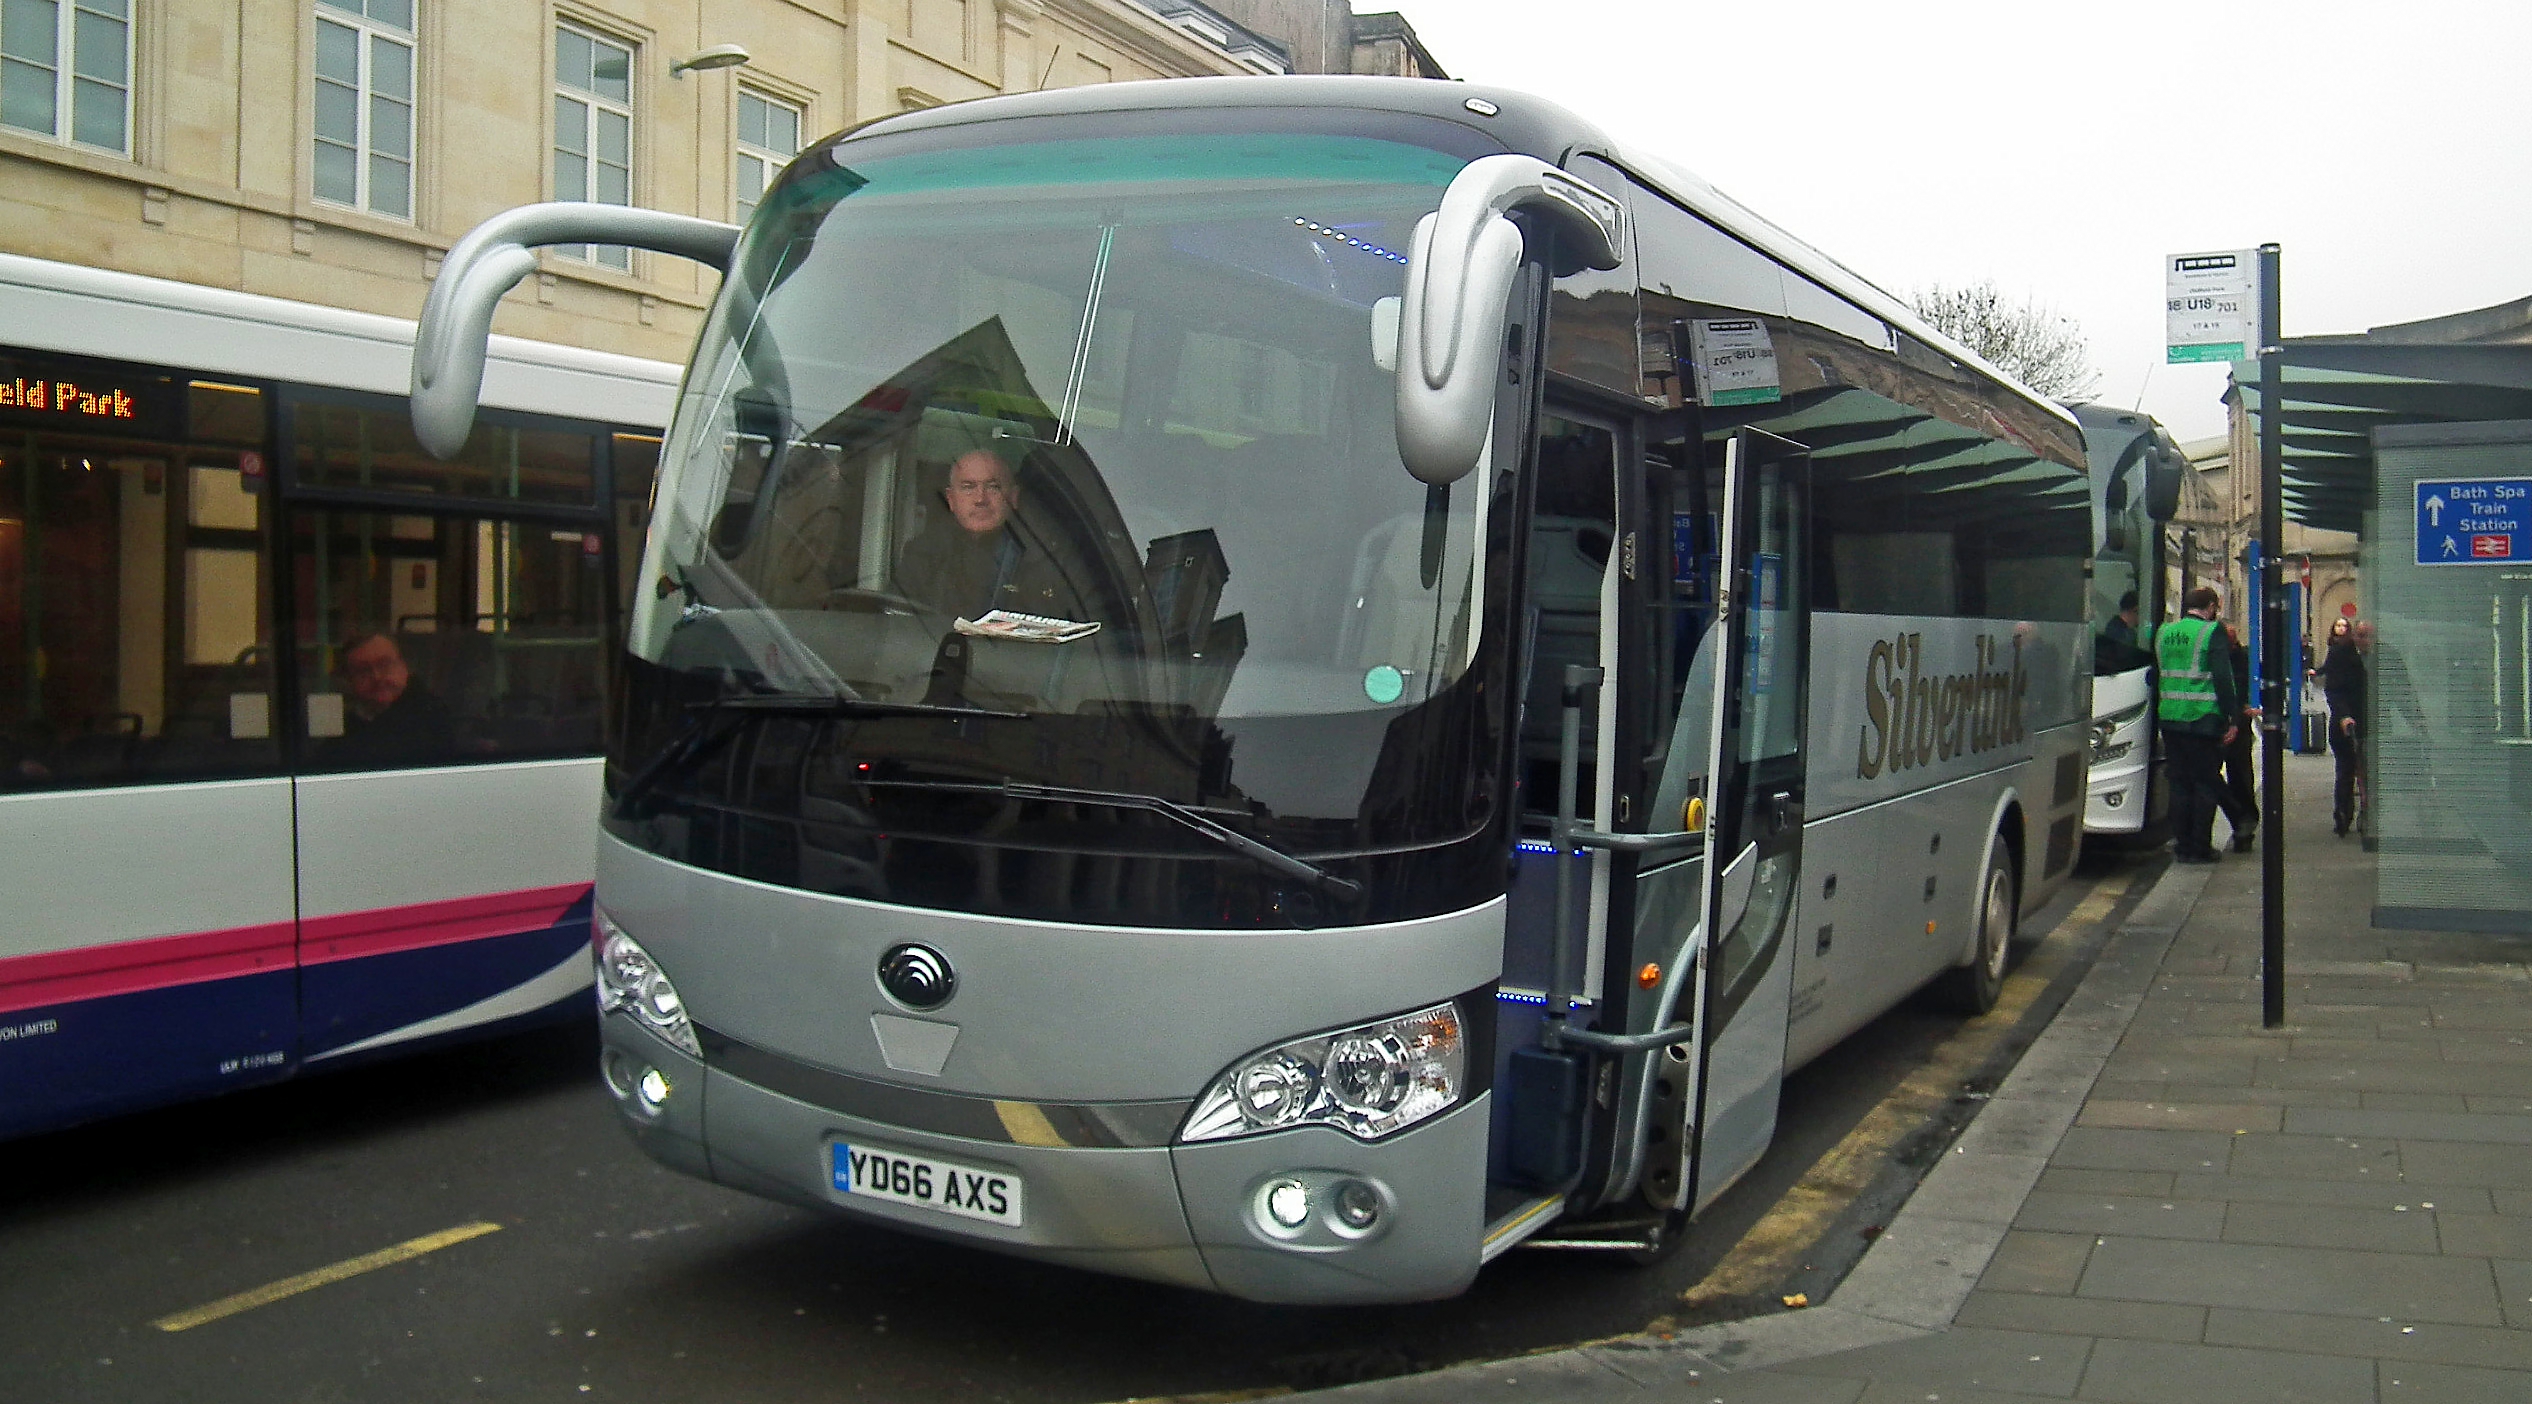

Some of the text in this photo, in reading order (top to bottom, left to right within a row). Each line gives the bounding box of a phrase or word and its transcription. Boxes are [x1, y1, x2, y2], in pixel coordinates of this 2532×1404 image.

[2187, 297, 2213, 310] U18
[2216, 302, 2239, 313] 701
[56, 381, 133, 418] Park
[2450, 485, 2526, 500] Bath Spa
[2470, 502, 2508, 516] Train
[2459, 518, 2518, 532] Station
[1857, 631, 2028, 780] Silverlink
[19, 1018, 58, 1038] LIMITED
[849, 1150, 1009, 1215] YD66 AXS
